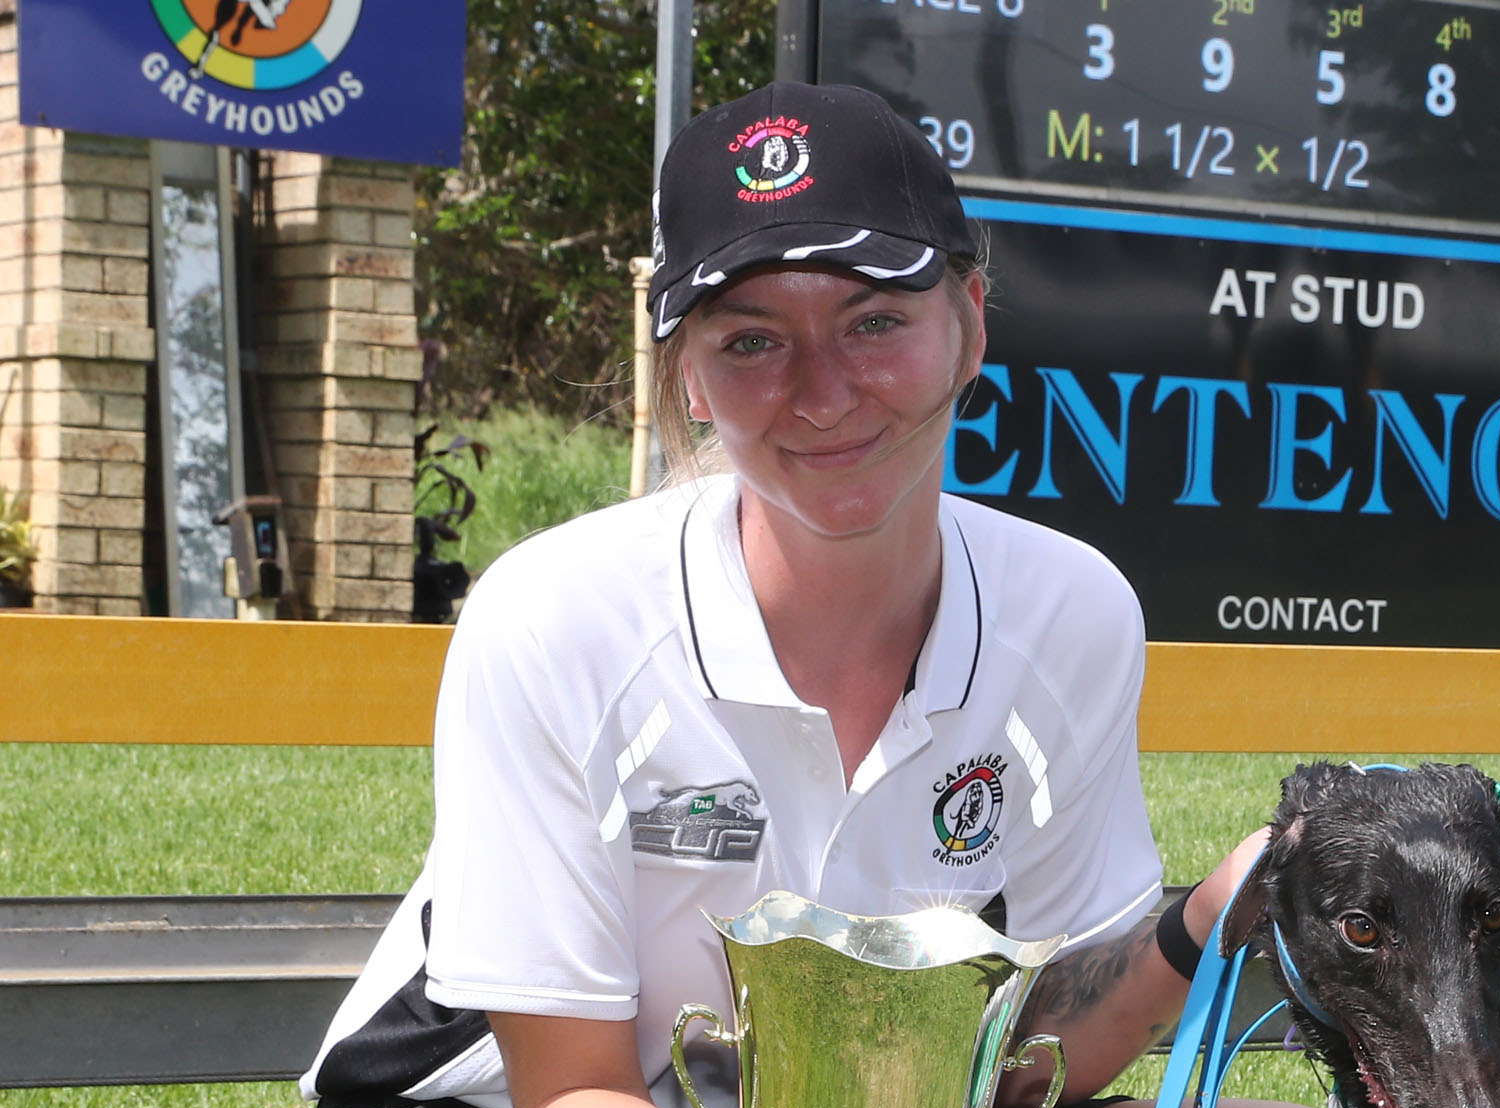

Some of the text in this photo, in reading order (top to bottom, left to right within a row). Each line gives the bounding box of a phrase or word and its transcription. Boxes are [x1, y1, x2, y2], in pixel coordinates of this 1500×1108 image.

[1326, 5, 1364, 39] 3rd
[1434, 17, 1472, 51] 4th
[1083, 23, 1115, 80] 3
[1201, 37, 1234, 93] 9
[1316, 50, 1346, 105] 5
[1425, 62, 1456, 117] 8
[140, 51, 364, 136] GREYHOUNDS
[728, 115, 811, 152] CAPALABA
[1047, 109, 1103, 163] M:
[1122, 118, 1140, 167] 1
[1165, 122, 1236, 179] 1/2
[1302, 136, 1369, 192] 1/2
[737, 175, 815, 203] GREYHOUNDS
[1209, 268, 1425, 330] AT STUD
[1218, 596, 1387, 634] CONTACT
[932, 752, 1009, 793] CAPALABA
[693, 799, 713, 810] TAB
[931, 833, 1001, 867] GREYHOUNDS
